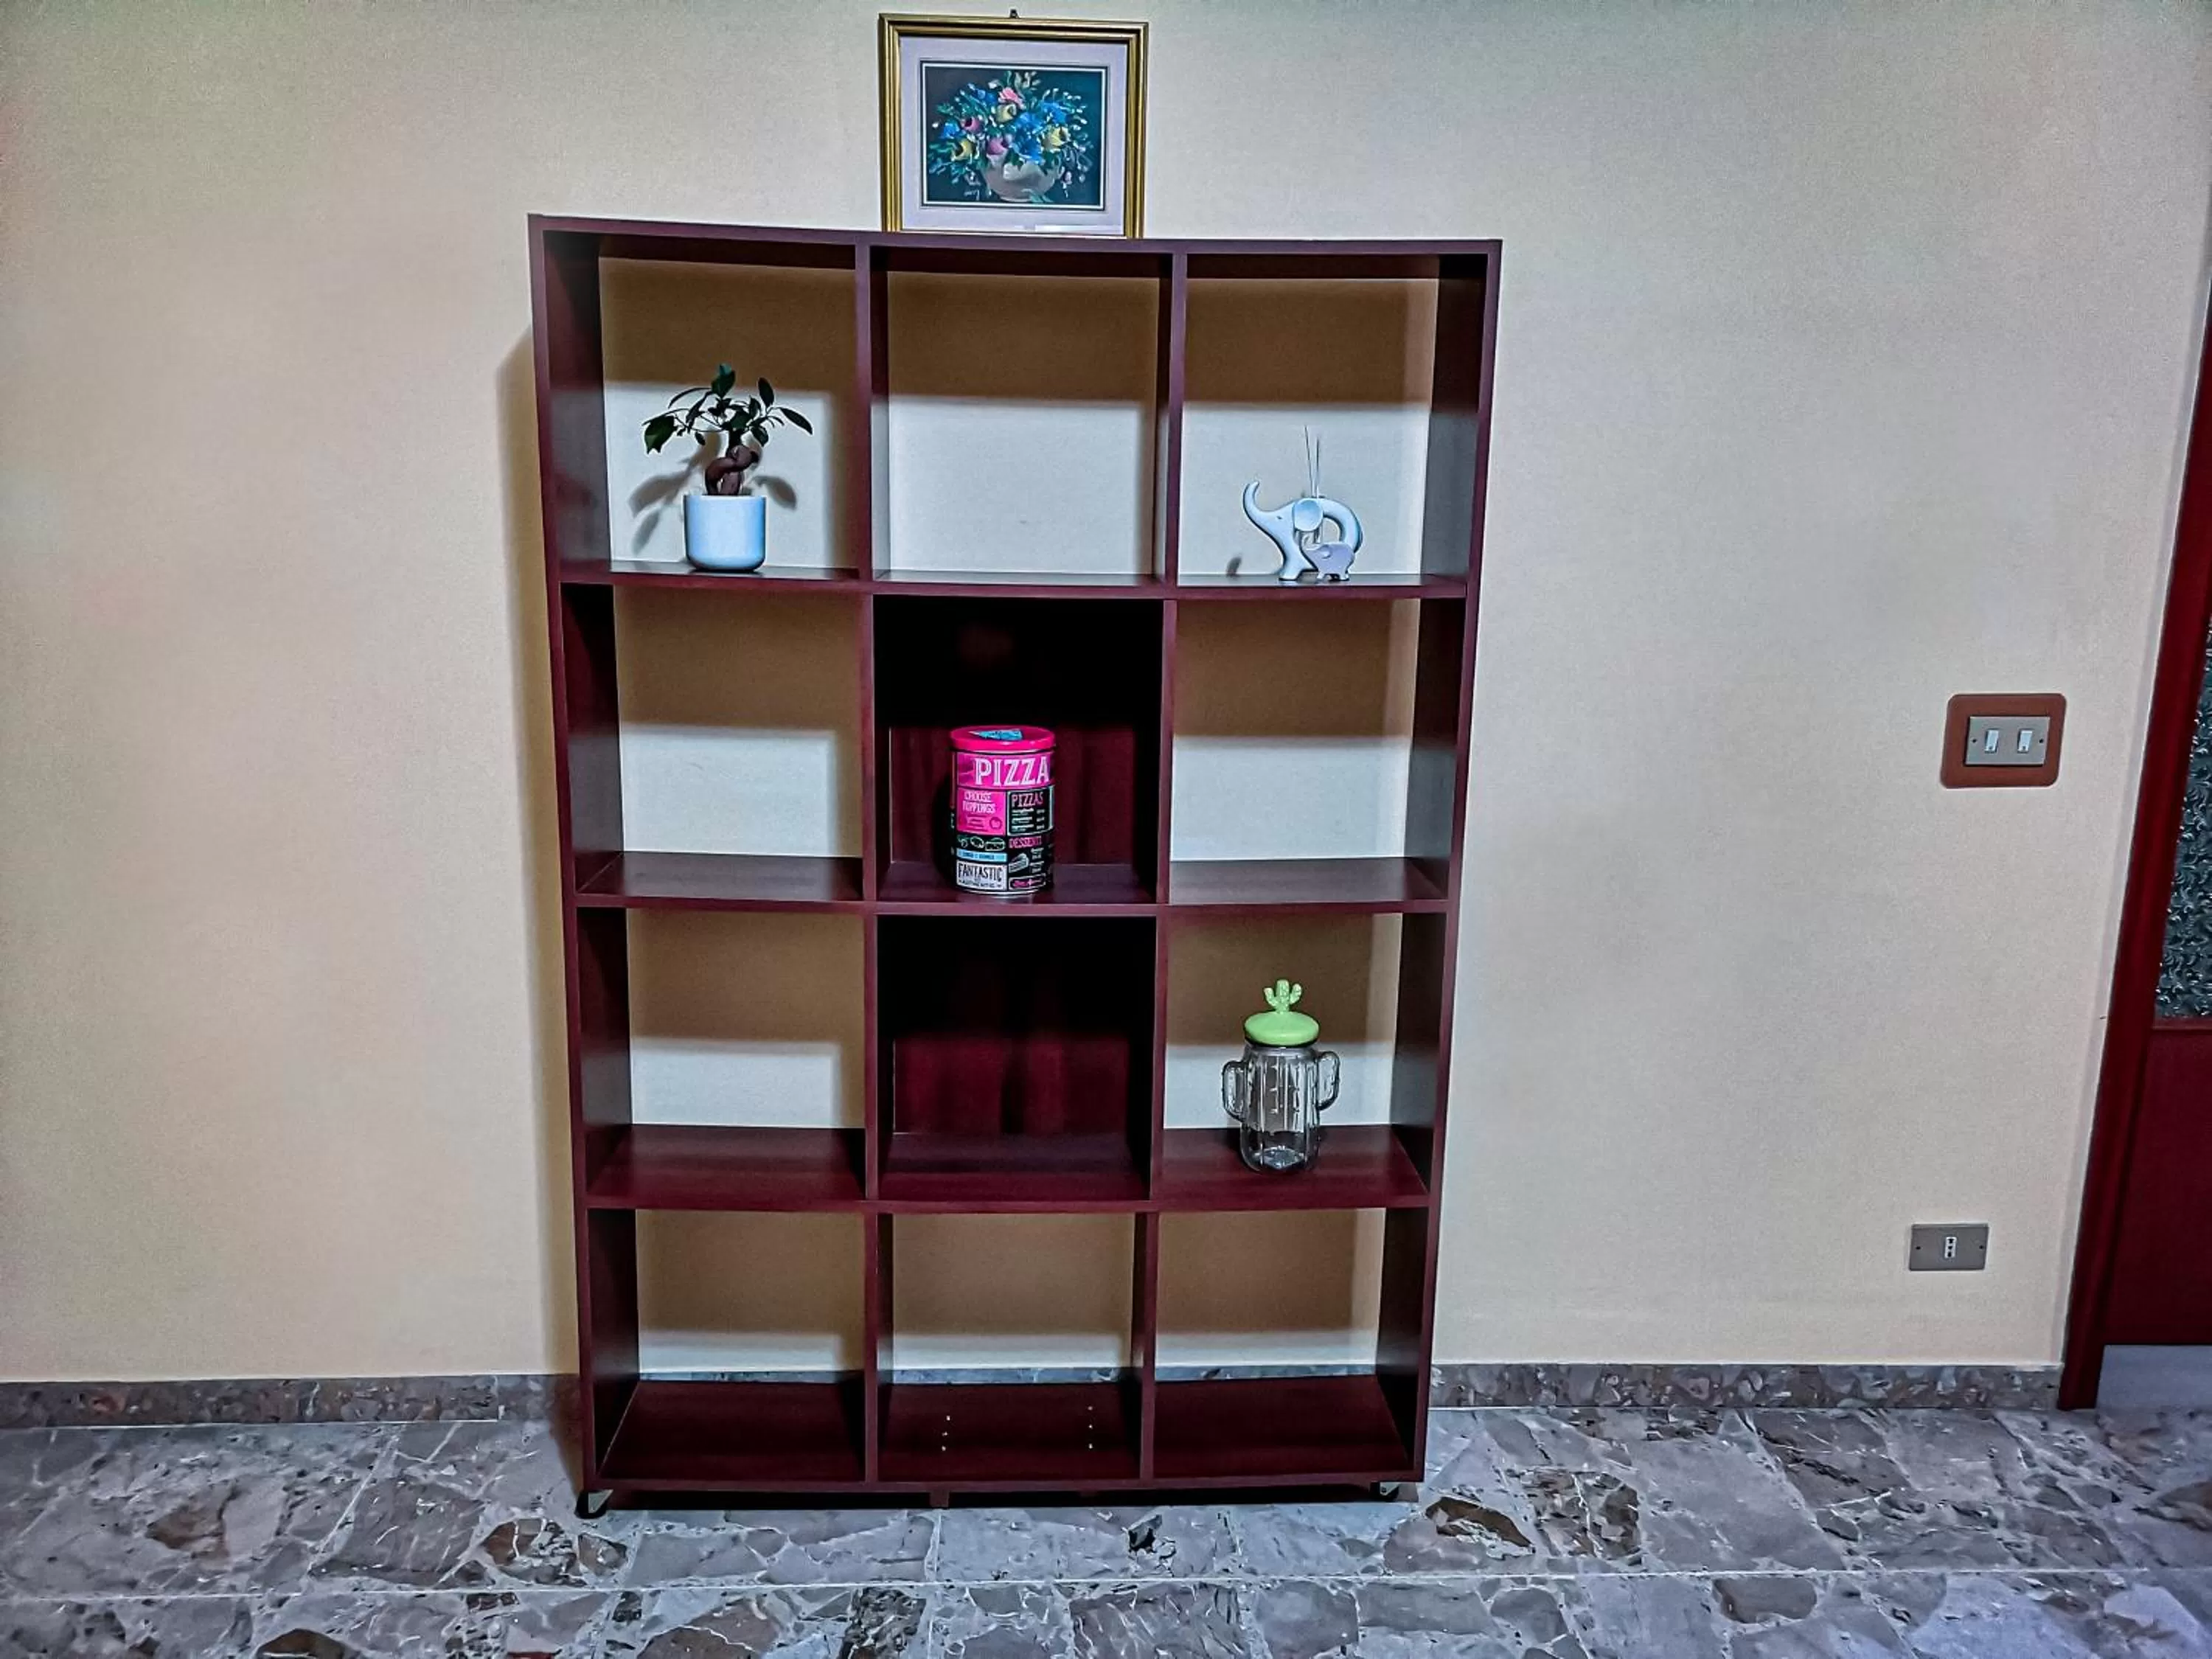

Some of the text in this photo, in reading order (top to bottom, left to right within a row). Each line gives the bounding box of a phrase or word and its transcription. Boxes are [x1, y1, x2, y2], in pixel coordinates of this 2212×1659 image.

[975, 757, 1049, 787] PIZZA
[1011, 792, 1043, 807] PIZZAS
[958, 863, 1003, 882] FANTASTIC
